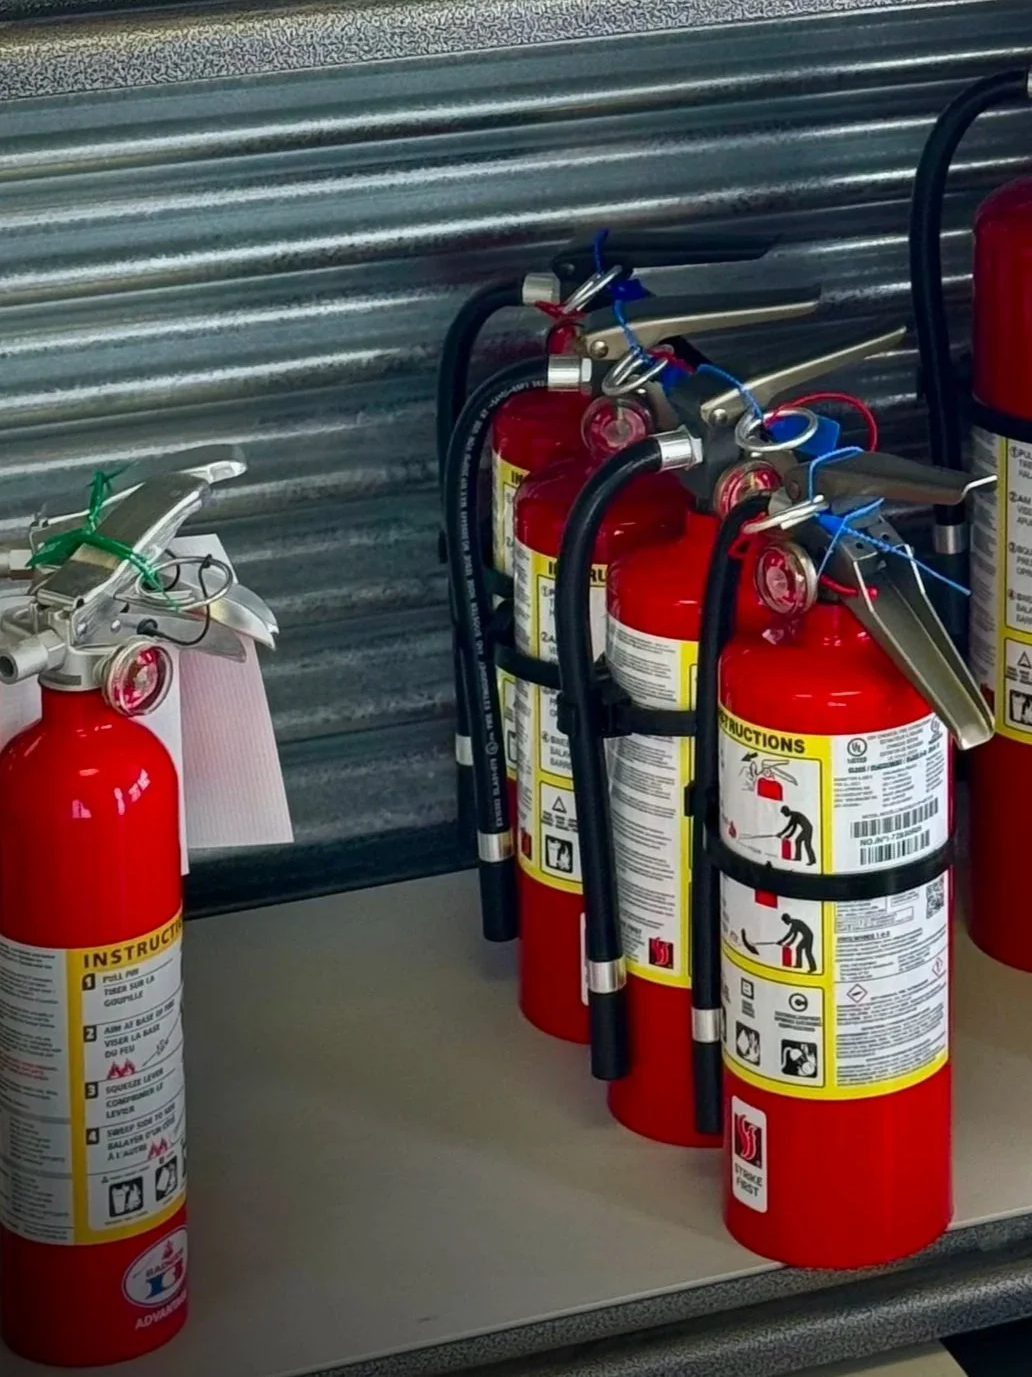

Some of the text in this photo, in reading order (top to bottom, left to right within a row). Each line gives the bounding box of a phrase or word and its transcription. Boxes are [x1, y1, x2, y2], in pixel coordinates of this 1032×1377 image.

[718, 714, 806, 755] STRUCTIONS
[83, 919, 183, 969] INSTRUCTI
[129, 979, 144, 990] SUR
[734, 1163, 763, 1188] STRIKE
[735, 1176, 761, 1199] FIRST
